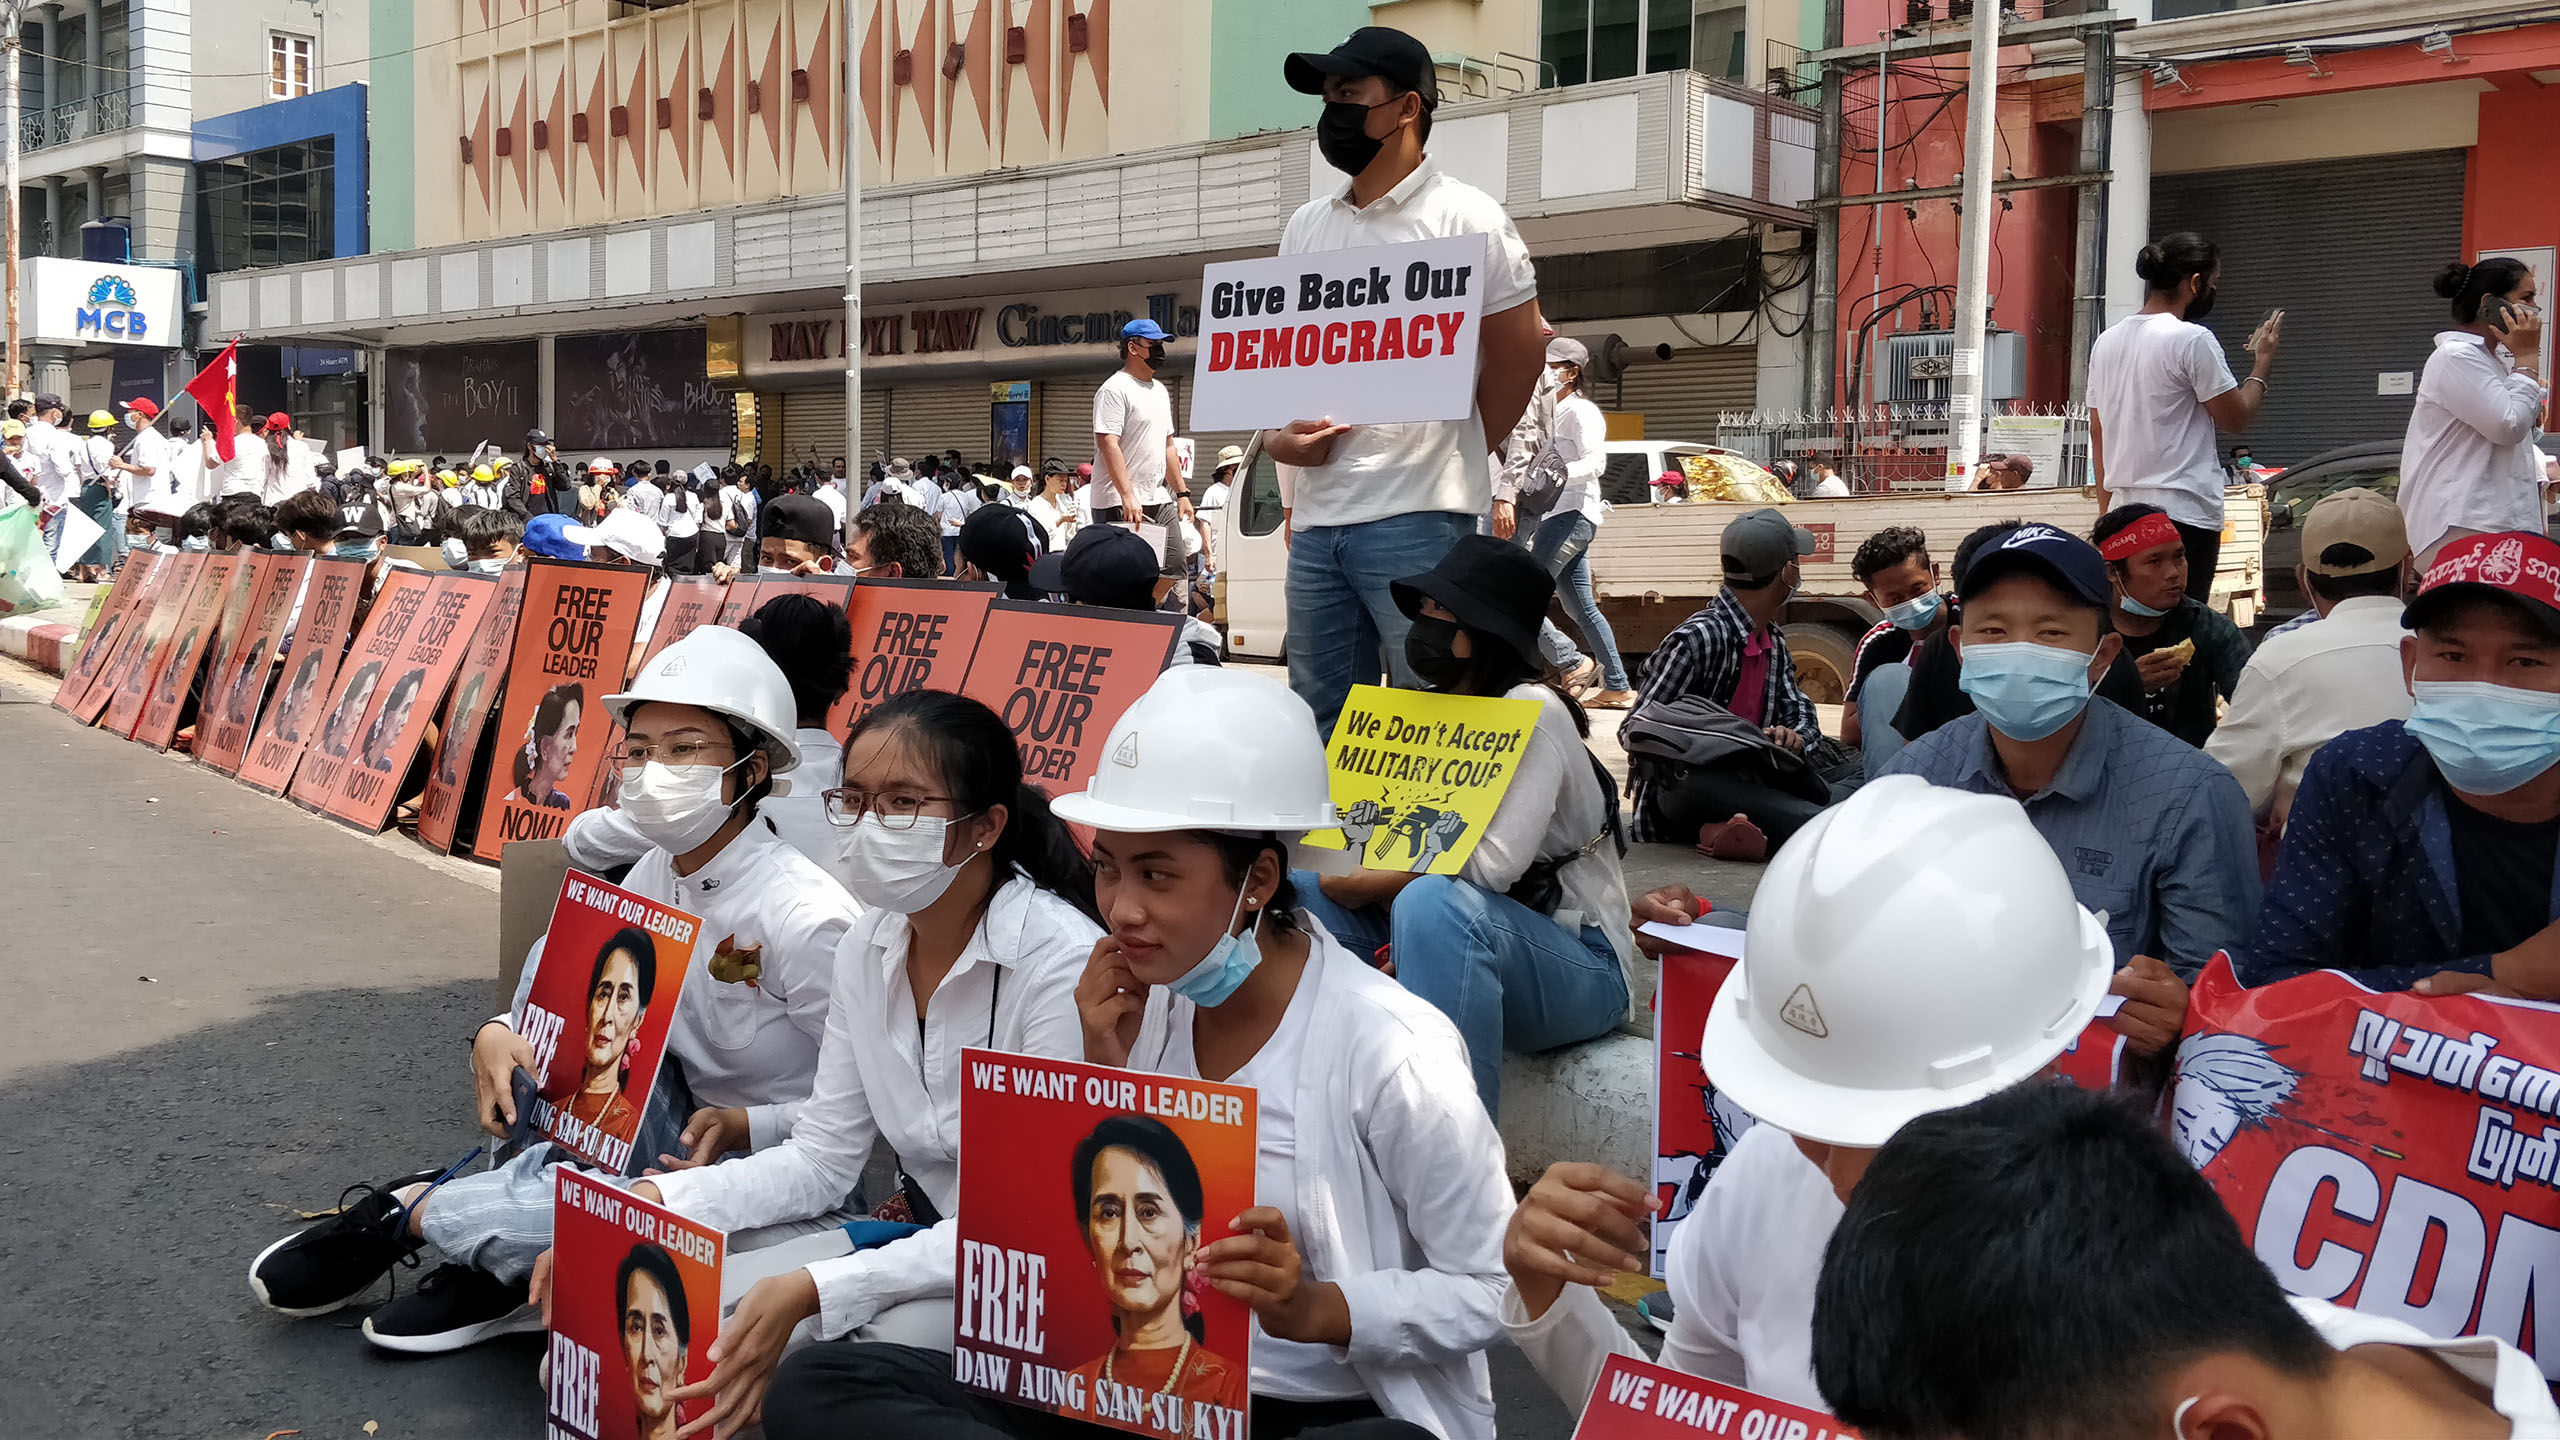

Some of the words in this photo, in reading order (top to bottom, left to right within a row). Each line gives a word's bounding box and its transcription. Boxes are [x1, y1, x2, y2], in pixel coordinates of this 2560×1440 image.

[1211, 280, 1285, 319] Give
[1298, 266, 1391, 311] Back
[1405, 261, 1471, 301] Our
[77, 308, 147, 335] MCB
[770, 319, 829, 361] NAY
[911, 307, 984, 353] TAW
[996, 303, 1137, 347] Cinema
[1147, 294, 1199, 336] Ha
[1208, 311, 1465, 372] DEMOCRACY
[1920, 359, 1940, 375] SEM
[464, 377, 504, 418] BOY
[507, 386, 518, 416] II
[342, 506, 366, 523] W
[2009, 526, 2056, 542] NIKE
[271, 568, 296, 592] FREE
[320, 575, 348, 601] FREE
[264, 591, 287, 616] OUR
[313, 599, 341, 628] OUR
[430, 590, 471, 620] FREE
[554, 584, 612, 621] FREE
[721, 602, 742, 624] EE
[307, 627, 334, 645] LEADER
[376, 610, 414, 641] OUR
[418, 616, 456, 648] OUR
[485, 614, 512, 648] OUR
[548, 617, 603, 656] OUR
[873, 612, 948, 658] FREE
[407, 645, 442, 666] LEADER
[542, 652, 598, 680] LEADER
[1015, 639, 1113, 695] FREE
[860, 655, 931, 700] OUR
[1001, 687, 1093, 747] OUR
[1346, 709, 1381, 739] We
[1384, 715, 1448, 747] Don't
[1446, 722, 1522, 760] Accept
[214, 726, 241, 755] NOW!
[255, 740, 293, 773] NOW!
[304, 754, 341, 791] NOW!
[1022, 744, 1076, 782] ADER
[1334, 744, 1443, 784] MILITARY
[1442, 758, 1503, 789] COUP
[342, 768, 385, 807] NOW!
[424, 783, 451, 825] NOW!
[499, 805, 564, 842] NOW!
[566, 878, 584, 902] WE
[584, 885, 620, 916] WANT
[618, 898, 645, 925] OUR
[644, 908, 693, 945] LEADER
[971, 1061, 1006, 1092] WE
[1012, 1067, 1078, 1102] WANT
[1084, 1078, 1136, 1111] OUR
[1144, 1084, 1243, 1126] LEADER
[530, 1098, 557, 1132] UNG
[555, 1110, 583, 1147] SAN
[581, 1124, 602, 1160] SU
[598, 1133, 630, 1172] KYI
[561, 1177, 581, 1208] WE
[584, 1187, 622, 1225] WANT
[625, 1206, 655, 1241] OUR
[658, 1219, 715, 1268] LEADER
[959, 1238, 1046, 1355] FREE
[550, 1330, 600, 1439] FREE
[955, 1345, 1010, 1394] DAW
[1018, 1360, 1086, 1412] AUNG
[1095, 1376, 1144, 1426] SAN
[1151, 1392, 1183, 1435] SU
[1193, 1402, 1244, 1440] KYI
[1609, 1369, 1654, 1412] WE
[1655, 1382, 1740, 1436] WANT
[1740, 1408, 1809, 1440] OUR
